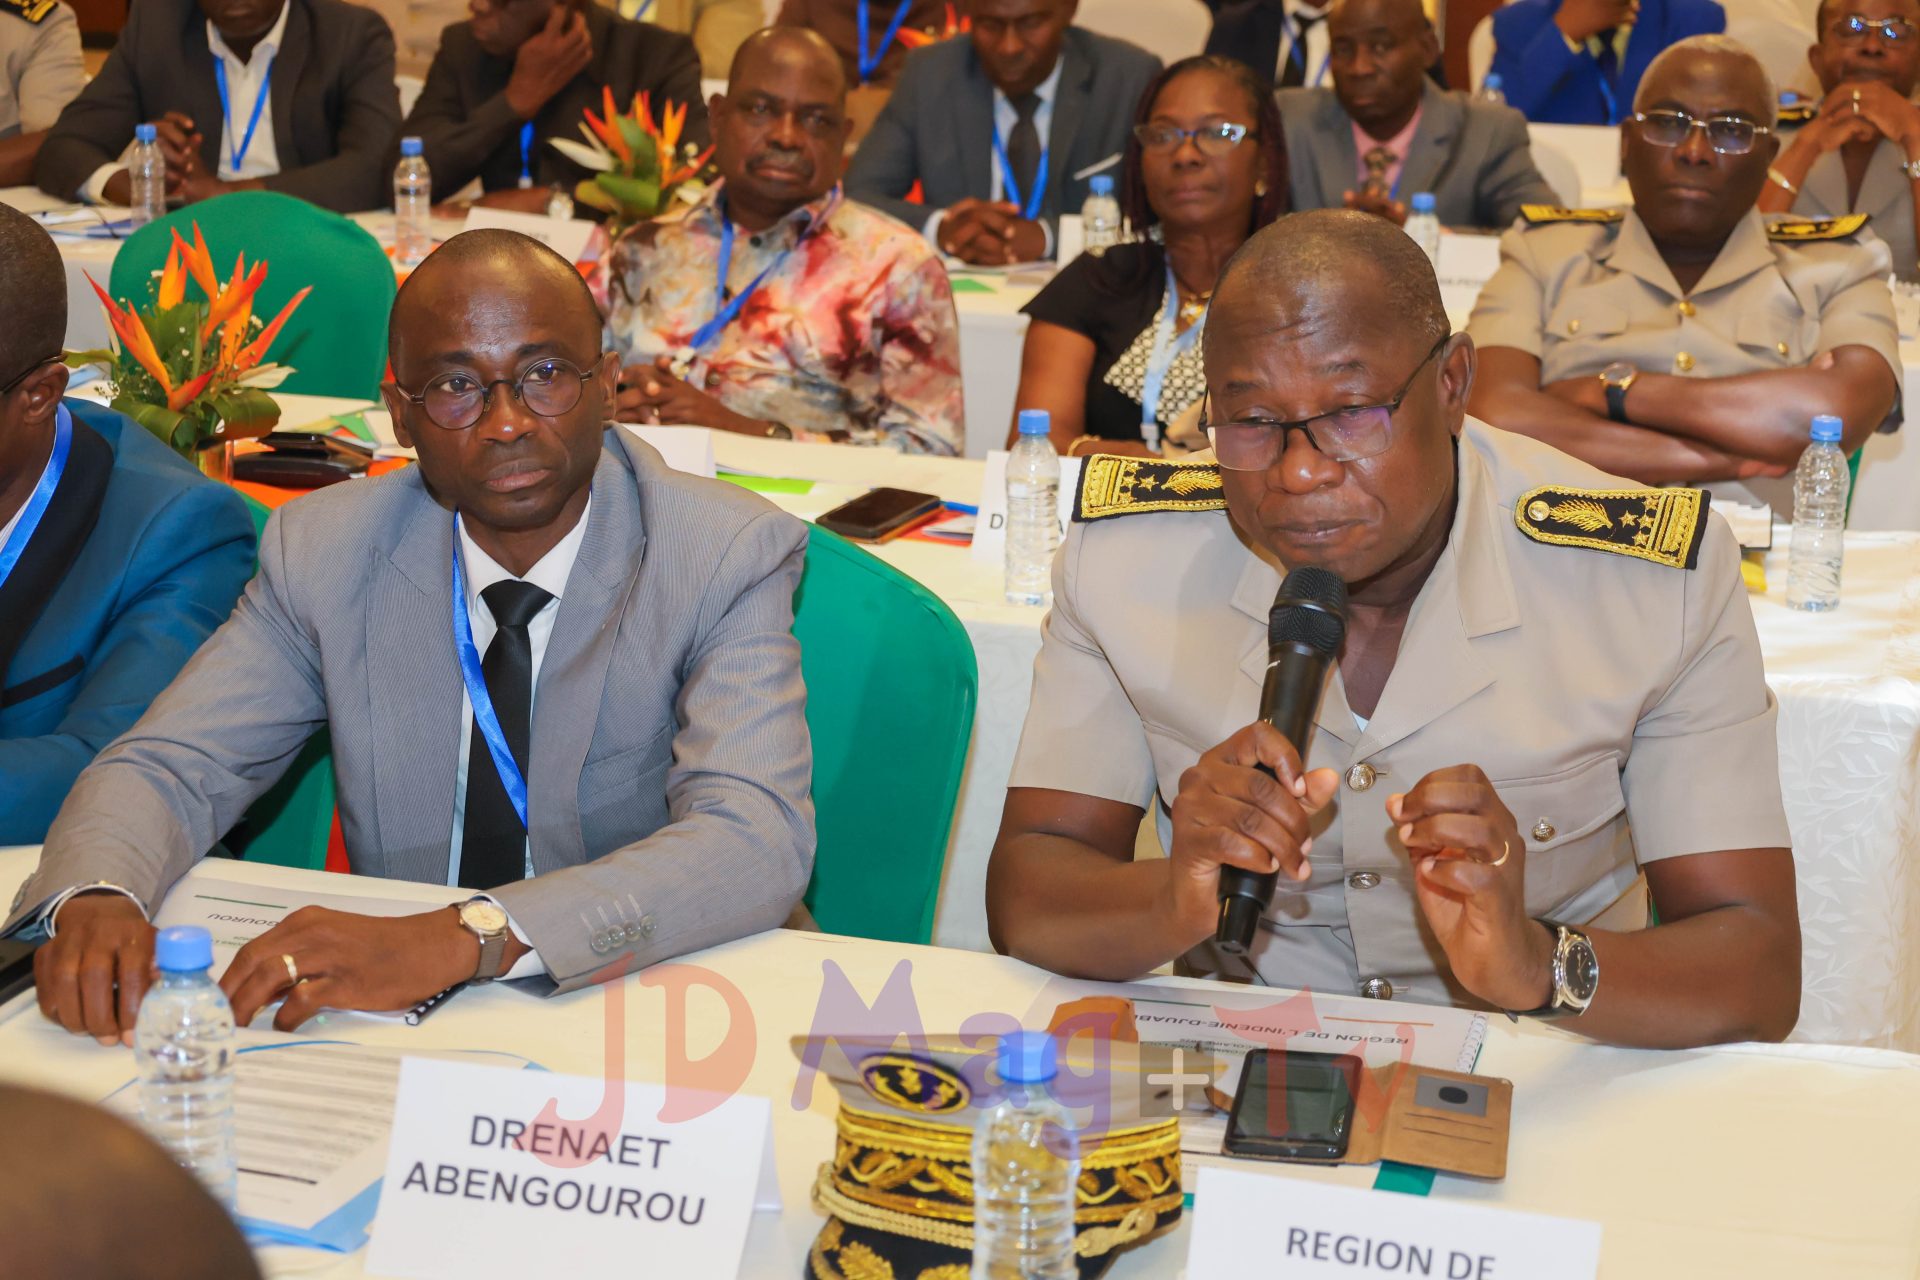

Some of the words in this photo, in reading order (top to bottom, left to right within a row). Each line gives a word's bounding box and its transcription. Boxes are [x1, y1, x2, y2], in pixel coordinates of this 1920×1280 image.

[207, 913, 281, 927] GOUROU
[1303, 1030, 1330, 1040] DE
[1335, 1033, 1409, 1045] REGION
[469, 1114, 671, 1169] DRENAET
[401, 1161, 706, 1226] ABENGOUROU
[1285, 1226, 1433, 1277] REGION
[1446, 1250, 1496, 1280] DE
